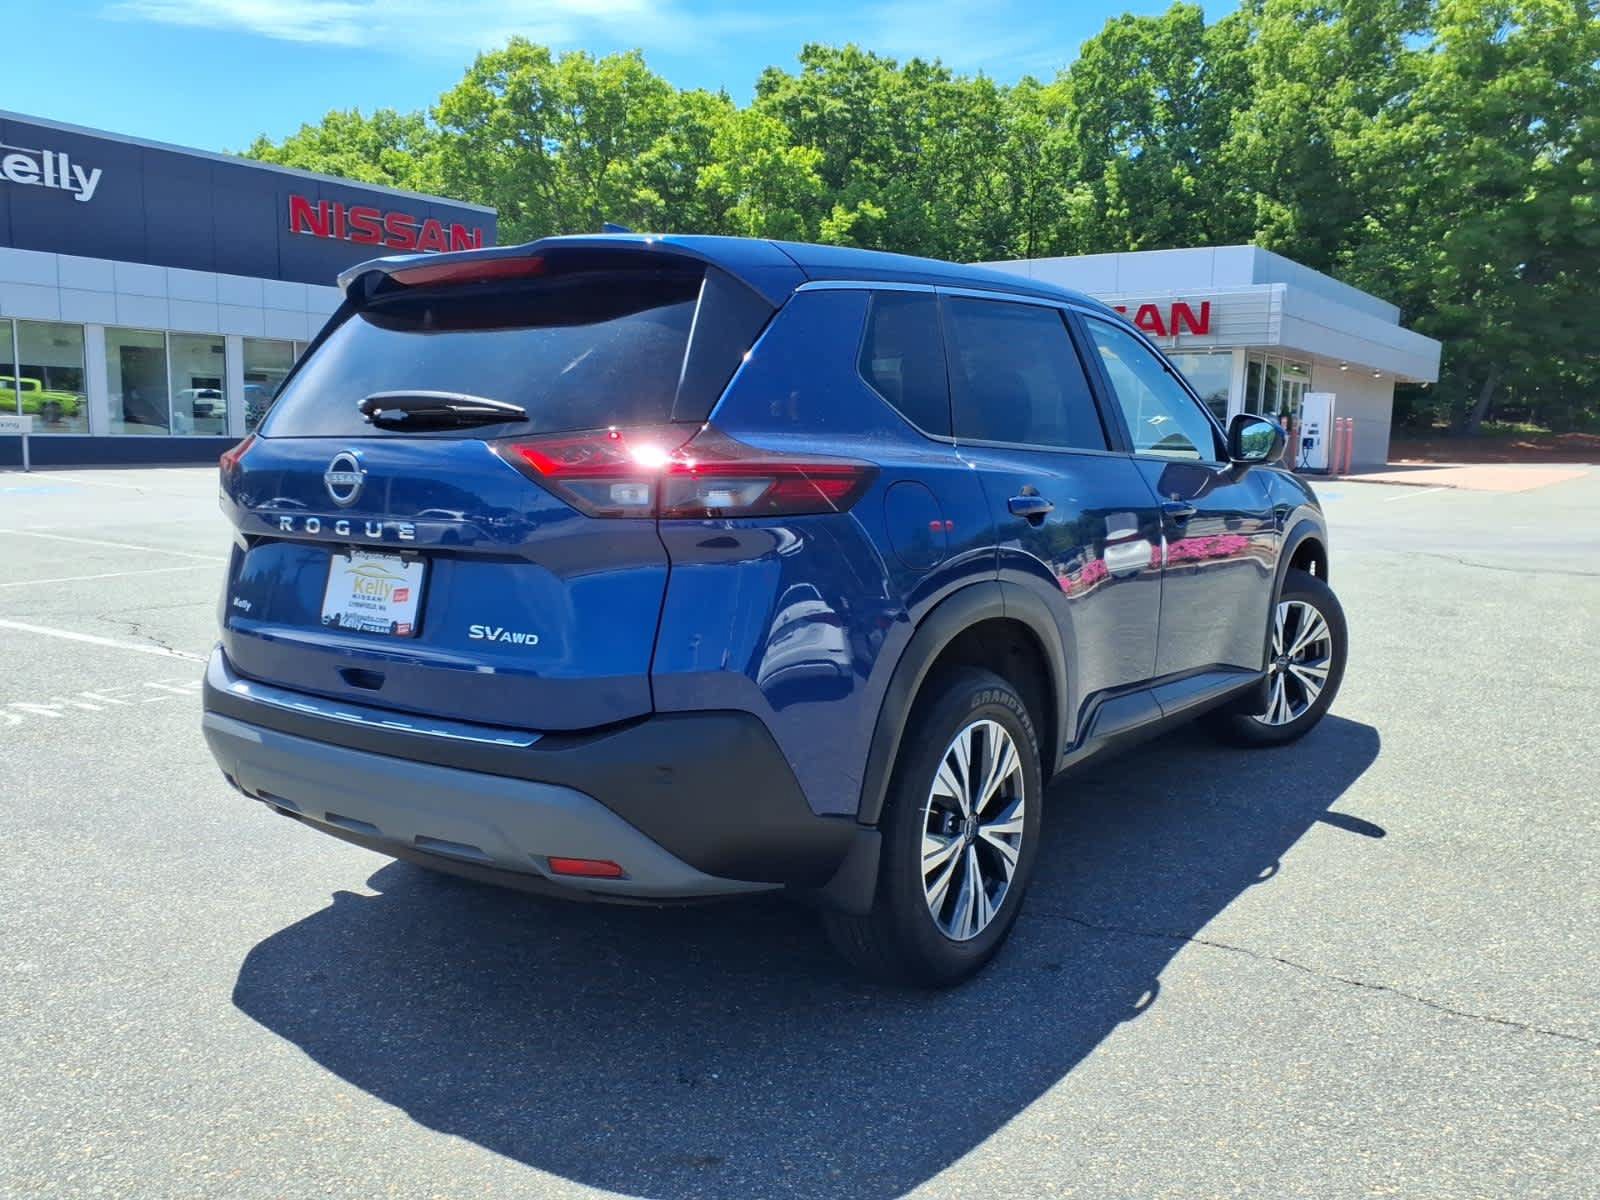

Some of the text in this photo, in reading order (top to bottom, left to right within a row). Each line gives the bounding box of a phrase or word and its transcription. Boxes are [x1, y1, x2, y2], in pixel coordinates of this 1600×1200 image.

[289, 194, 484, 253] NISSAN
[1113, 300, 1211, 337] AN
[279, 515, 416, 540] ROGUE
[353, 576, 393, 600] Kelly
